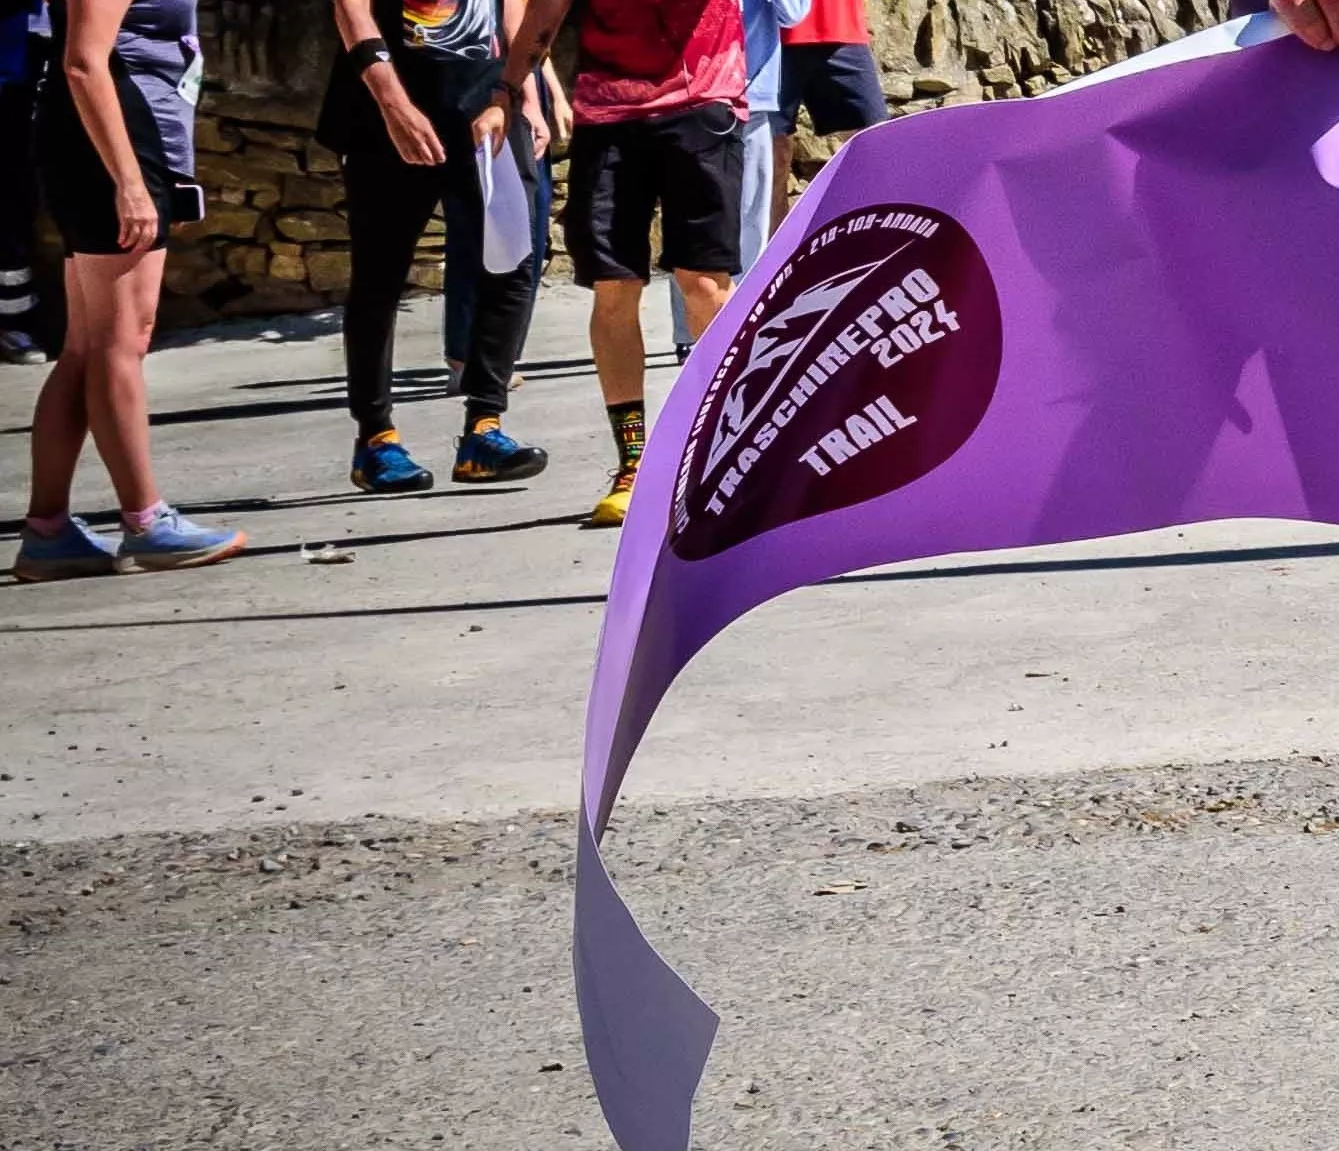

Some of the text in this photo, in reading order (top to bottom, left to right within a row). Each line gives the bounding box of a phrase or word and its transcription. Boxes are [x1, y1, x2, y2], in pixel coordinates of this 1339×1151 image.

[870, 299, 961, 369] 2024
[704, 267, 942, 517] TRASCHINEPRO
[798, 395, 918, 477] TRAIL
